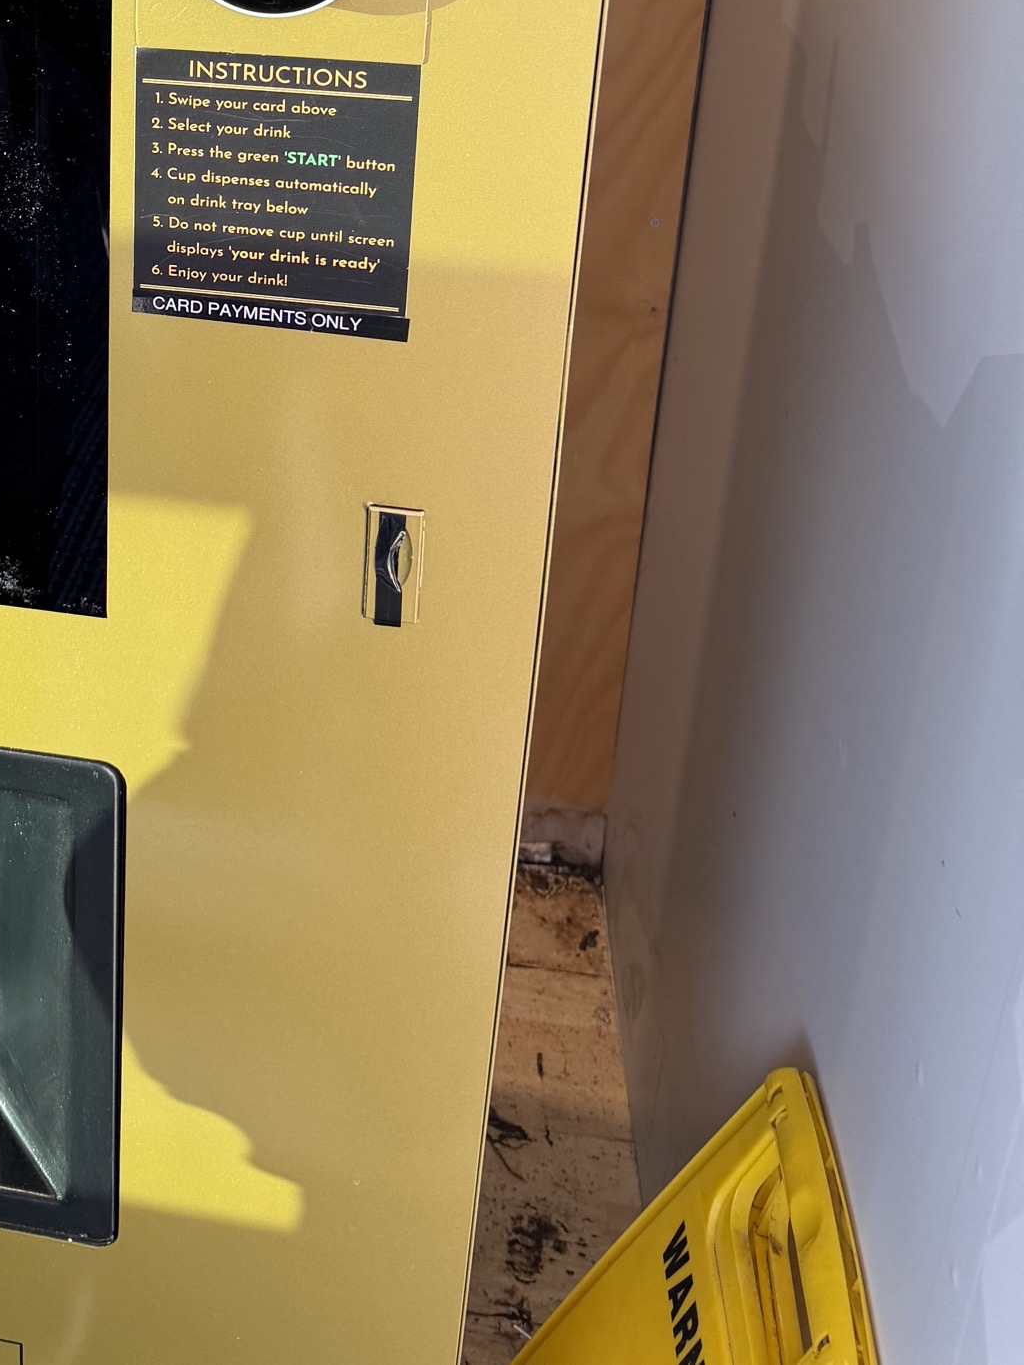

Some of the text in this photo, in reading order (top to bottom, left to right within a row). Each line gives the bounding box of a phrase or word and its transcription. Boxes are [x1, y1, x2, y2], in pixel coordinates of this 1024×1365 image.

[189, 59, 368, 89] INSTRUCTIONS
[155, 92, 337, 116] 1. Swipe your card above
[151, 117, 291, 138] 2. Select your drink
[151, 142, 396, 172] 3. Press the green 'START' button
[151, 167, 377, 197] 4. Cup dispenses automatically
[168, 195, 308, 215] on drink tray below
[153, 217, 395, 247] 5. Do not remove cup until screen
[167, 241, 380, 272] displays 'your drink is ready'
[151, 264, 288, 286] 6. Enjoy your drink!
[152, 296, 362, 332] CARD PAYMENTS ONLY
